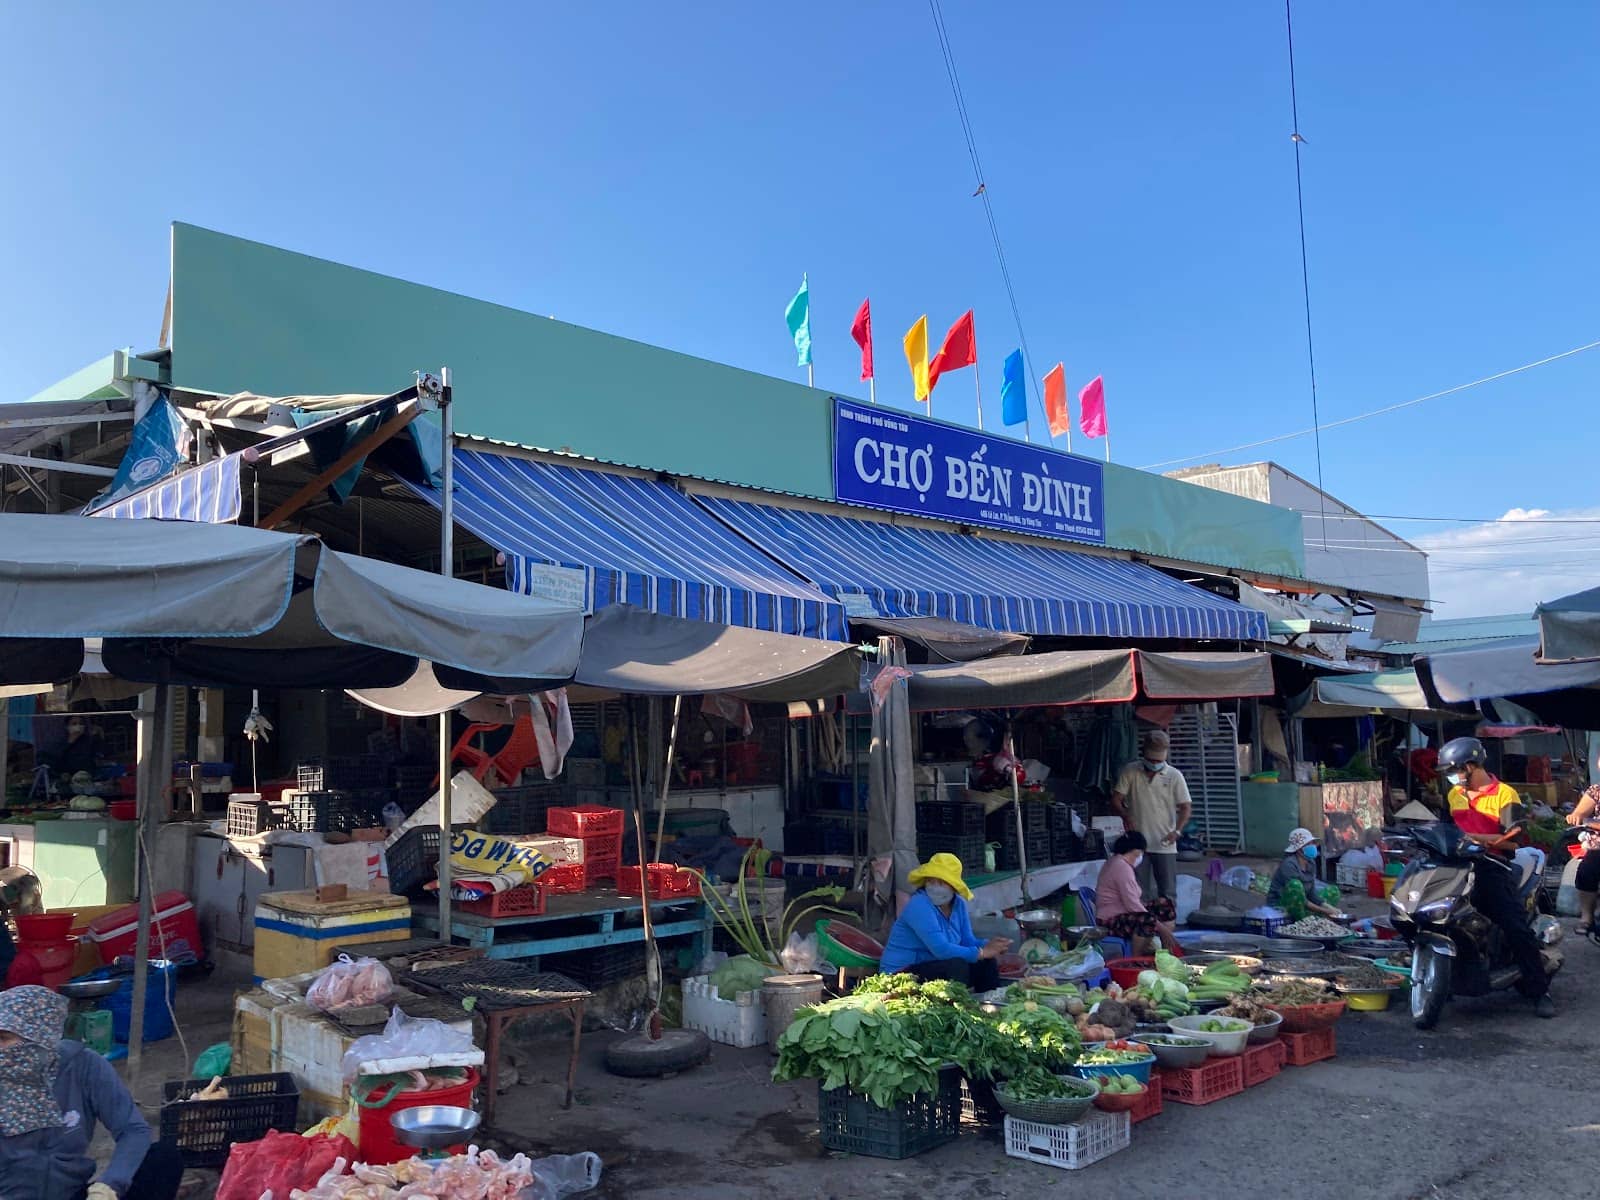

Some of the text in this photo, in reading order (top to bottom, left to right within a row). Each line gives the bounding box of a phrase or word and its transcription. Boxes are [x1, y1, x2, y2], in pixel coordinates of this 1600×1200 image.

[854, 437, 1093, 522] CHỢ BẾN ĐÌNH
